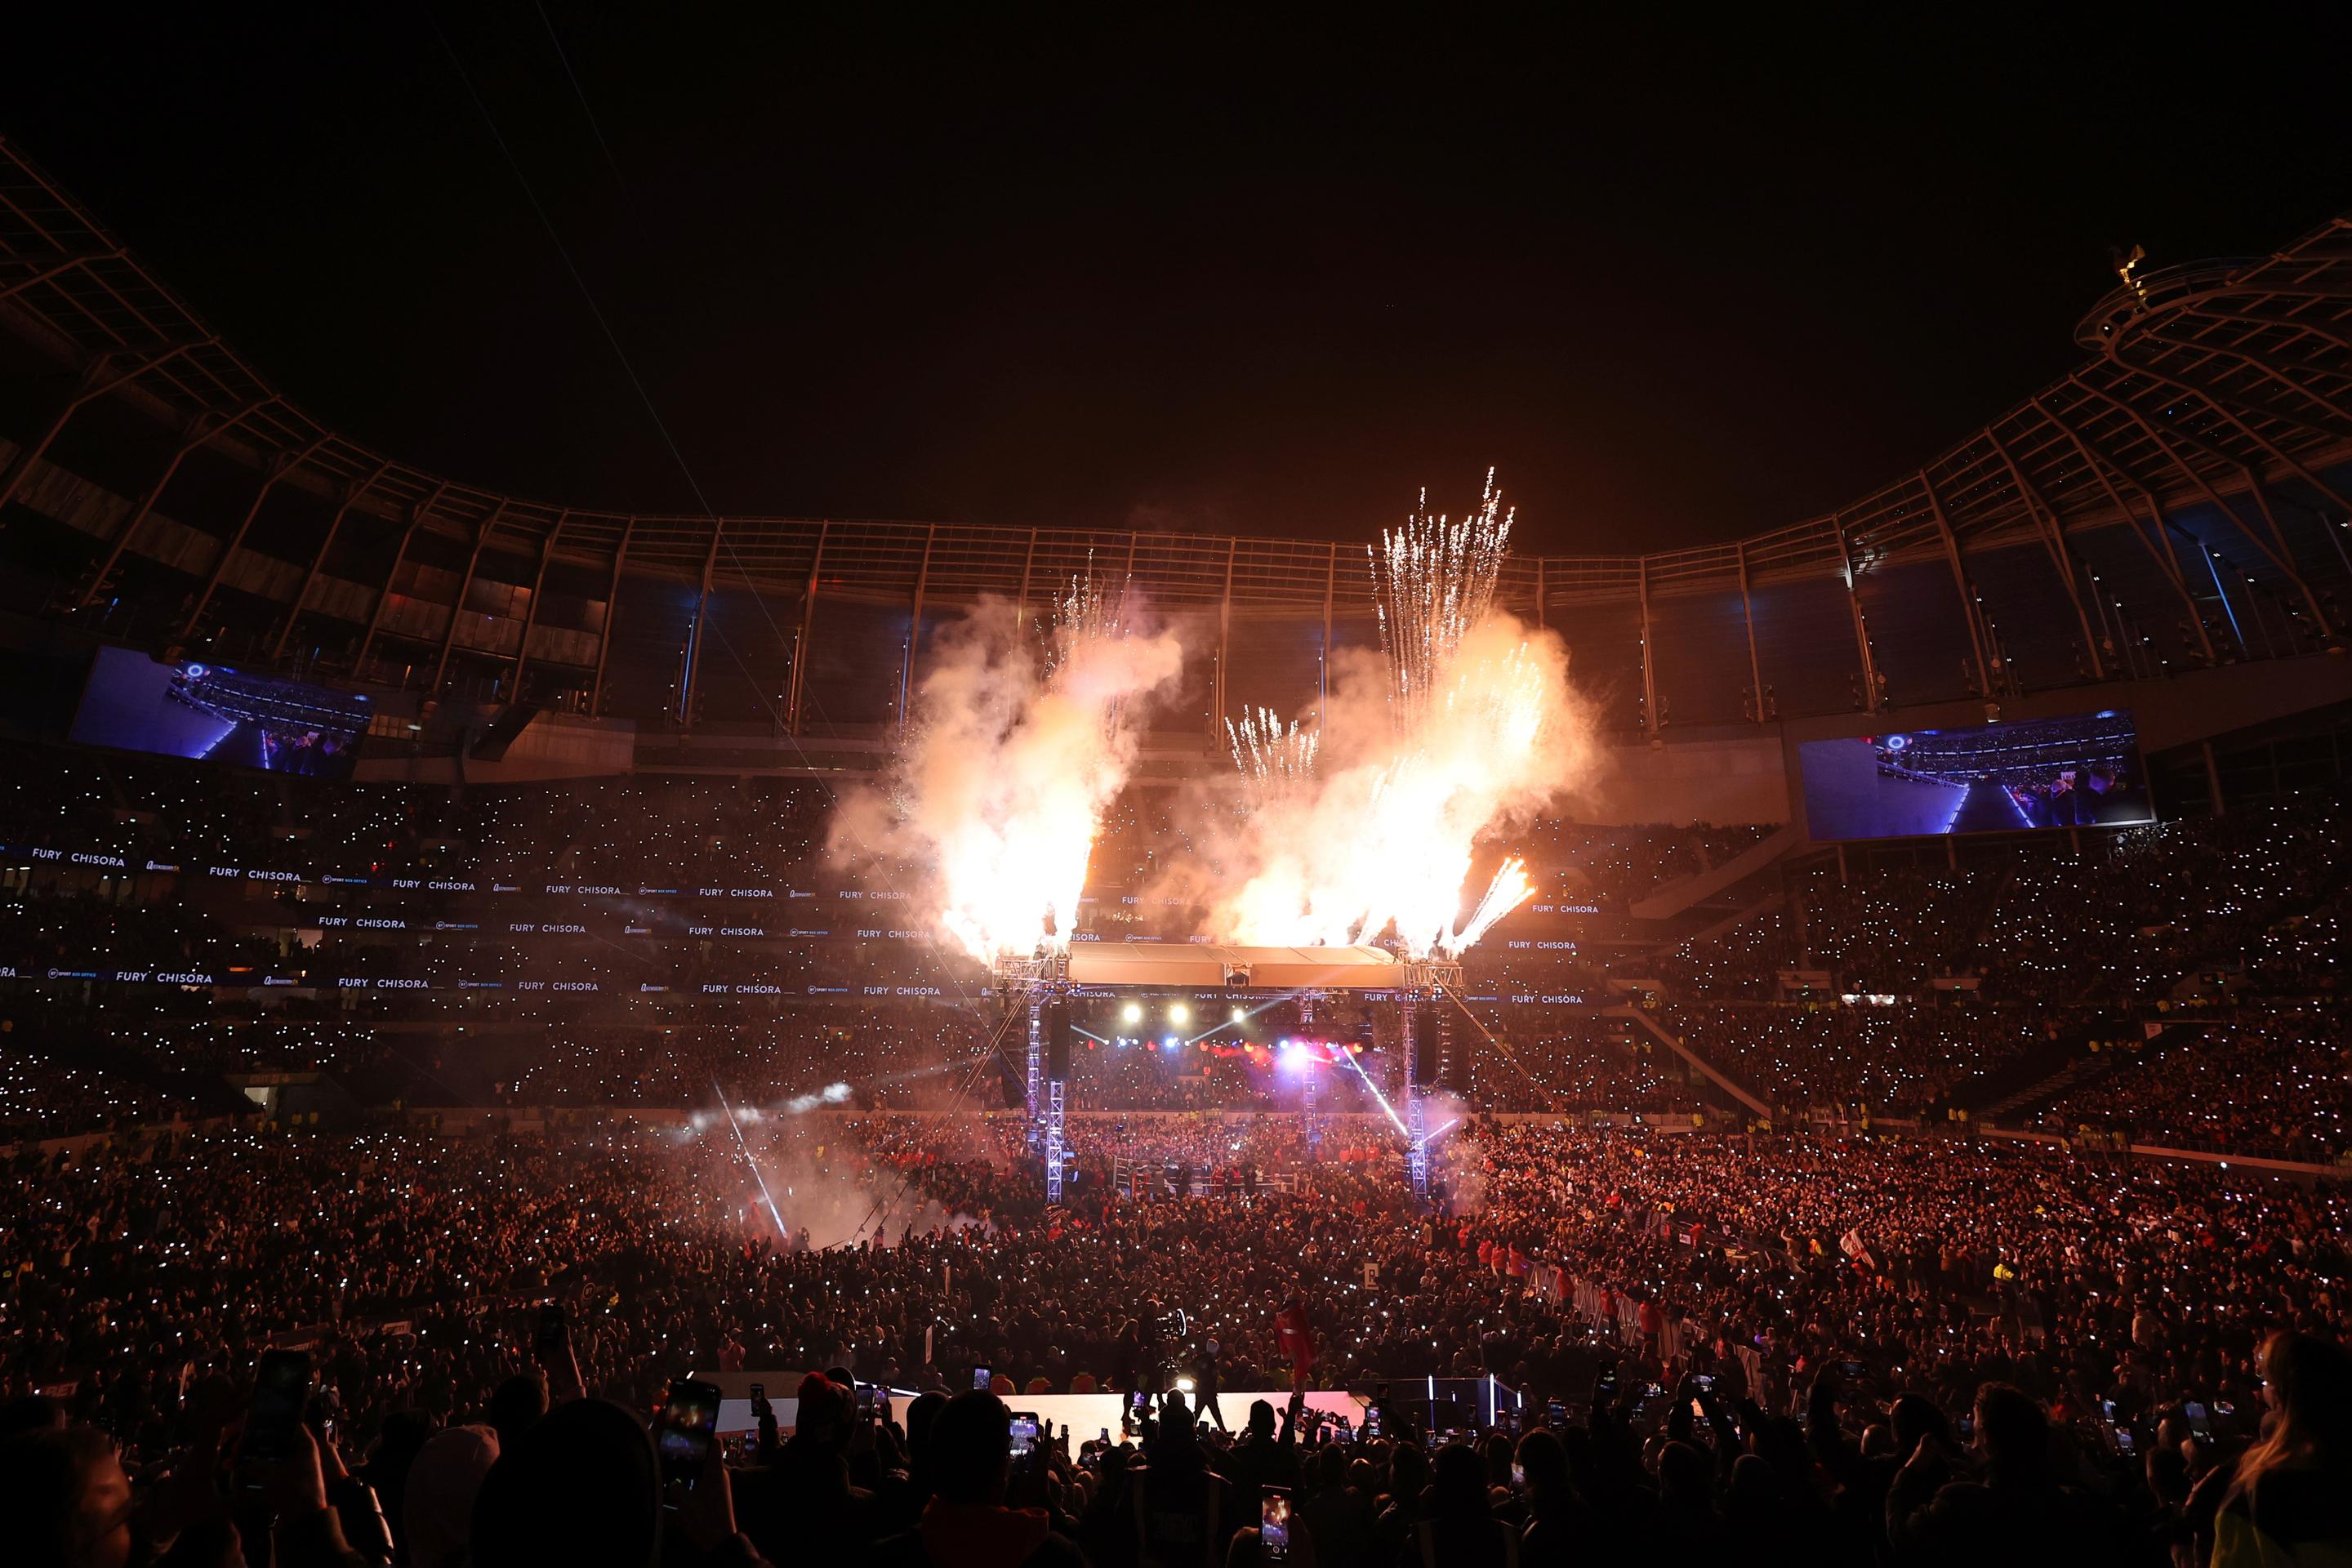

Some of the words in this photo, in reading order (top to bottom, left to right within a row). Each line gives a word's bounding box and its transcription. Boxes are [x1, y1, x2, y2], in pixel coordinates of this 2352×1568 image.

[33, 849, 63, 860] FURY
[71, 853, 125, 867] CHISORA
[210, 866, 240, 877] FURY
[248, 870, 301, 882] CHISORA
[393, 880, 421, 889] FURY
[429, 881, 475, 891] CHISORA
[577, 886, 621, 895] CHISORA
[699, 889, 724, 897] FURY
[731, 889, 773, 898] CHISORA
[840, 891, 863, 899] FURY
[870, 891, 912, 900] CHISORA
[318, 916, 348, 926] FURY
[356, 919, 405, 929] CHISORA
[542, 924, 586, 933] CHISORA
[720, 928, 764, 936] CHISORA
[858, 929, 882, 938] FURY
[889, 930, 929, 938] CHISORA
[0, 967, 16, 977] RA
[116, 972, 148, 981] FURY
[157, 973, 212, 983] CHISORA
[338, 978, 368, 987] FURY
[377, 979, 428, 988] CHISORA
[519, 982, 545, 990] FURY
[552, 982, 598, 991] CHISORA
[702, 985, 728, 993] FURY
[737, 985, 781, 994] CHISORA
[864, 987, 889, 995] FURY
[897, 987, 941, 996] CHISORA
[1364, 993, 1388, 1001] FURY
